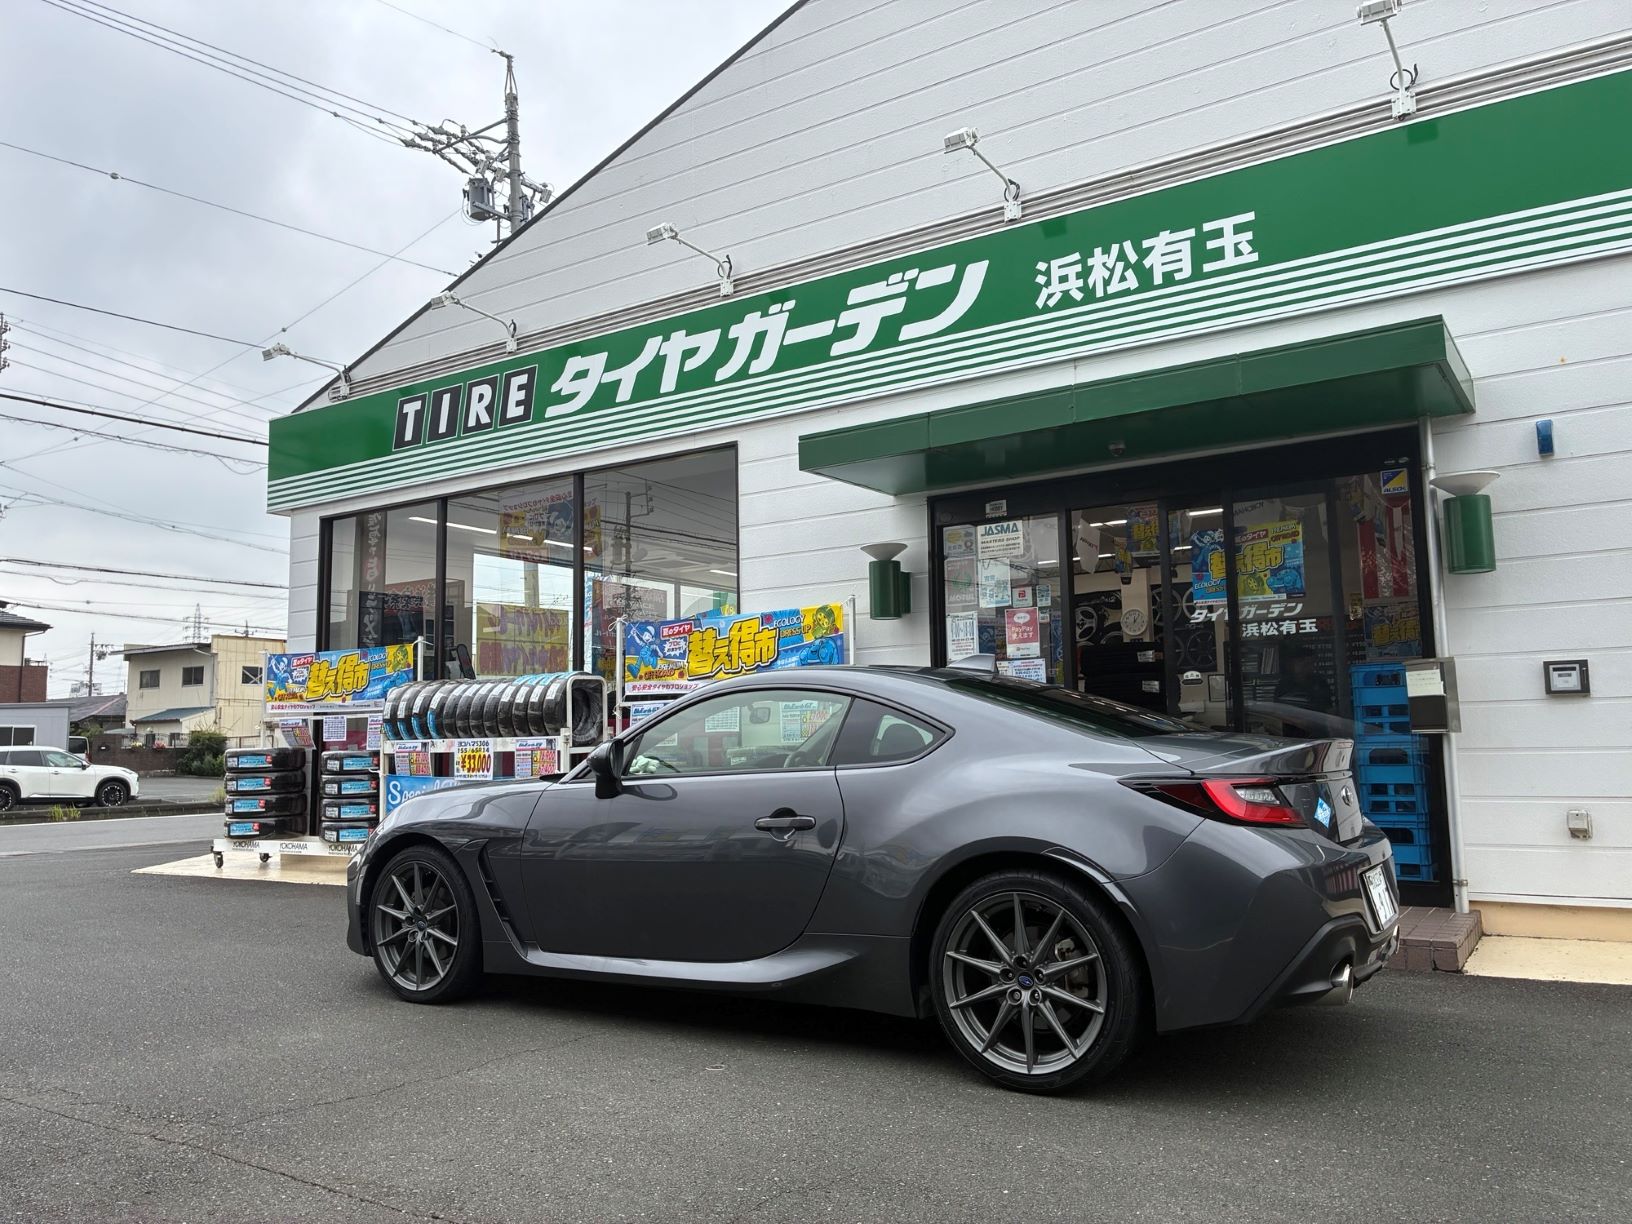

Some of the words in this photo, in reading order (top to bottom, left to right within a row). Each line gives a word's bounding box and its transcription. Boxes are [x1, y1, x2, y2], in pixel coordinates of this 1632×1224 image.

[401, 372, 531, 444] TIRE
[545, 259, 989, 418] タイヤガーデン
[1034, 210, 1259, 310] 浜松有玉
[981, 522, 1019, 536] JASMA
[774, 615, 806, 628] ECOLOGY
[1242, 618, 1318, 637] 浜松有玉
[688, 618, 777, 677] 替え得市
